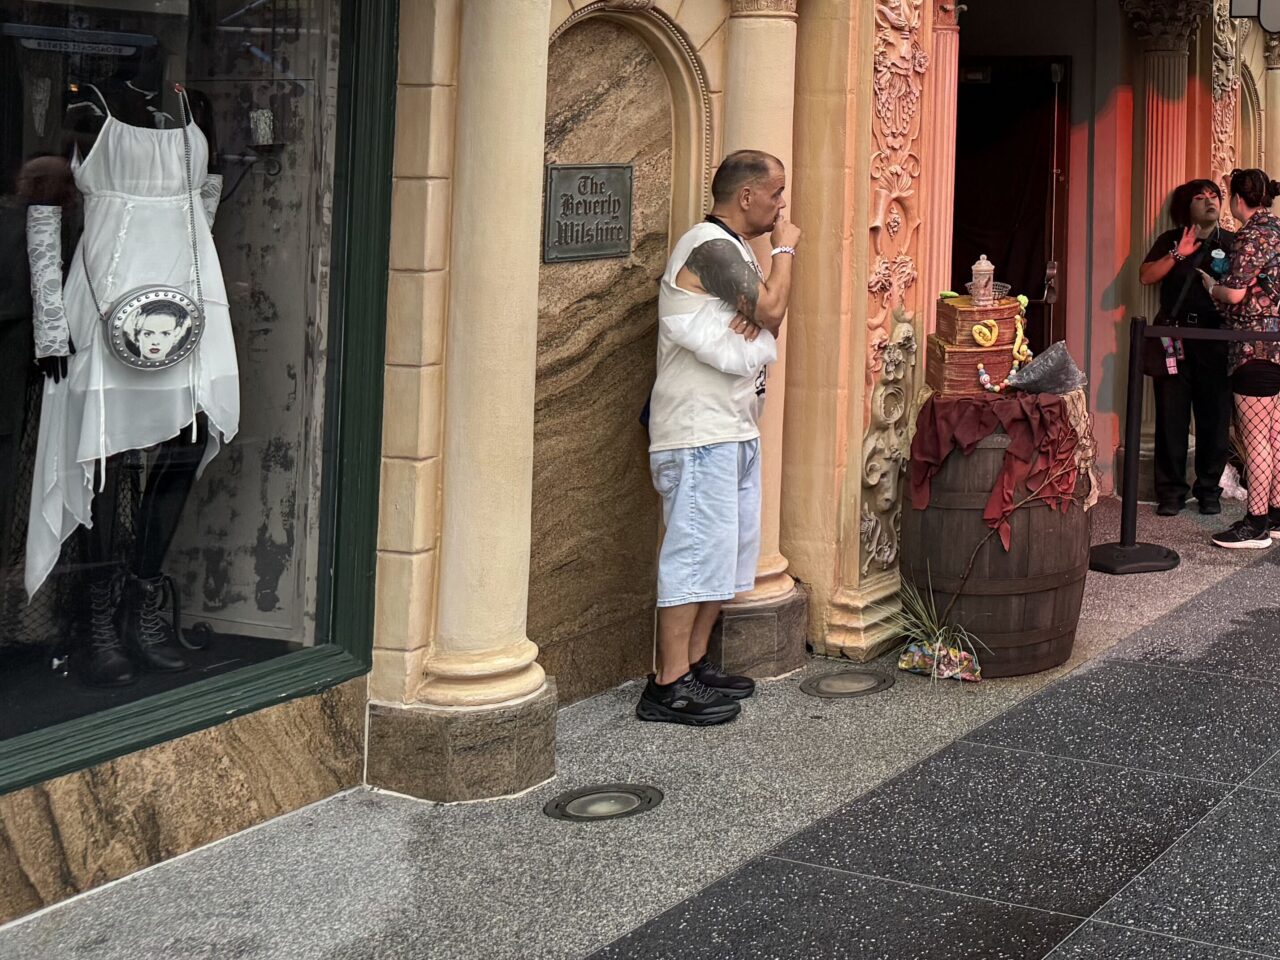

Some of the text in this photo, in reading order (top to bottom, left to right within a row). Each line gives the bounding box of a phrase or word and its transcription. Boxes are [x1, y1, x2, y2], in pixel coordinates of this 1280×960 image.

[577, 175, 606, 195] The
[560, 192, 621, 220] Beverly
[554, 220, 623, 246] Wilshire
